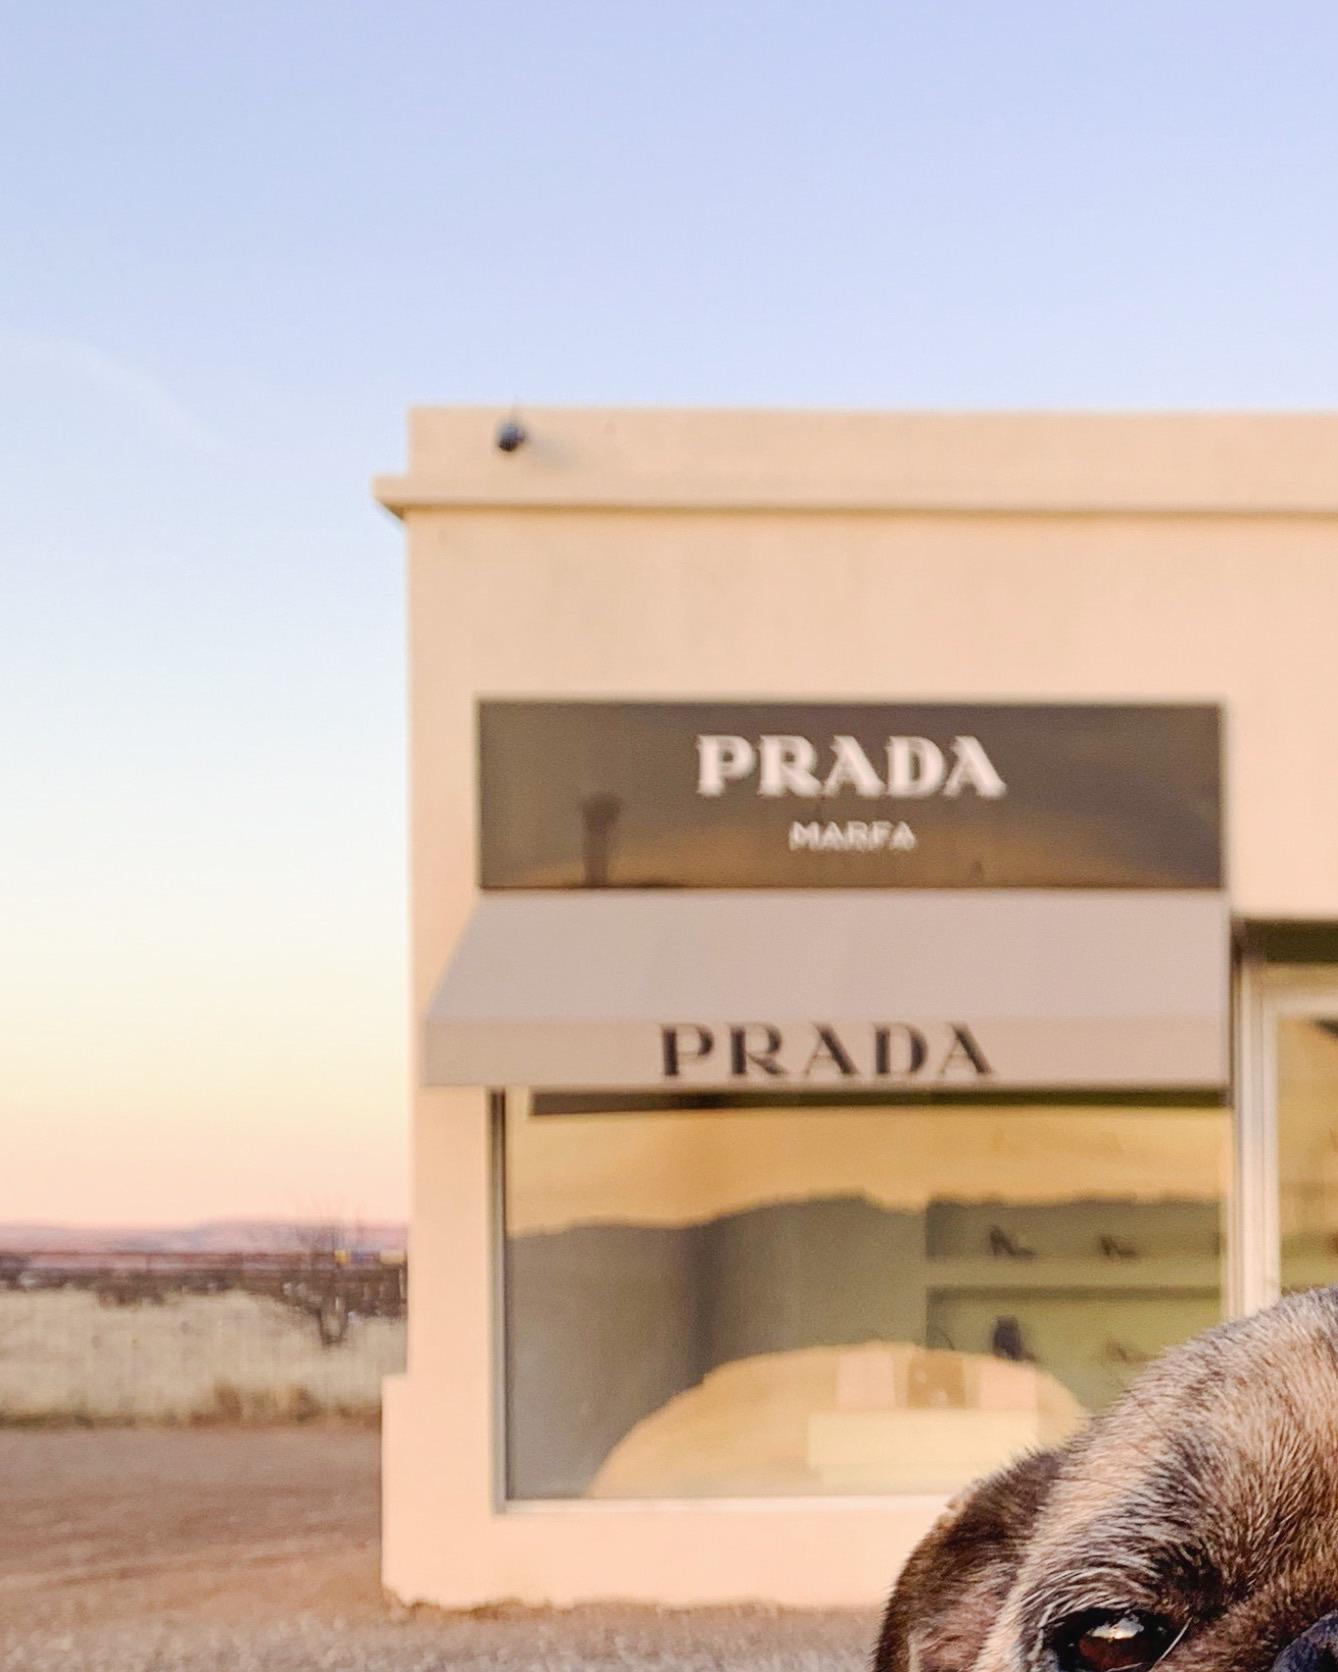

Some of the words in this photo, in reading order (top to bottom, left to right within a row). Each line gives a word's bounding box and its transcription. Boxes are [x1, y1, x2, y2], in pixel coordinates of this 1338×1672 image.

[696, 733, 1006, 798] PRADA
[789, 820, 918, 853] MARFA
[660, 1022, 994, 1078] PRADA
